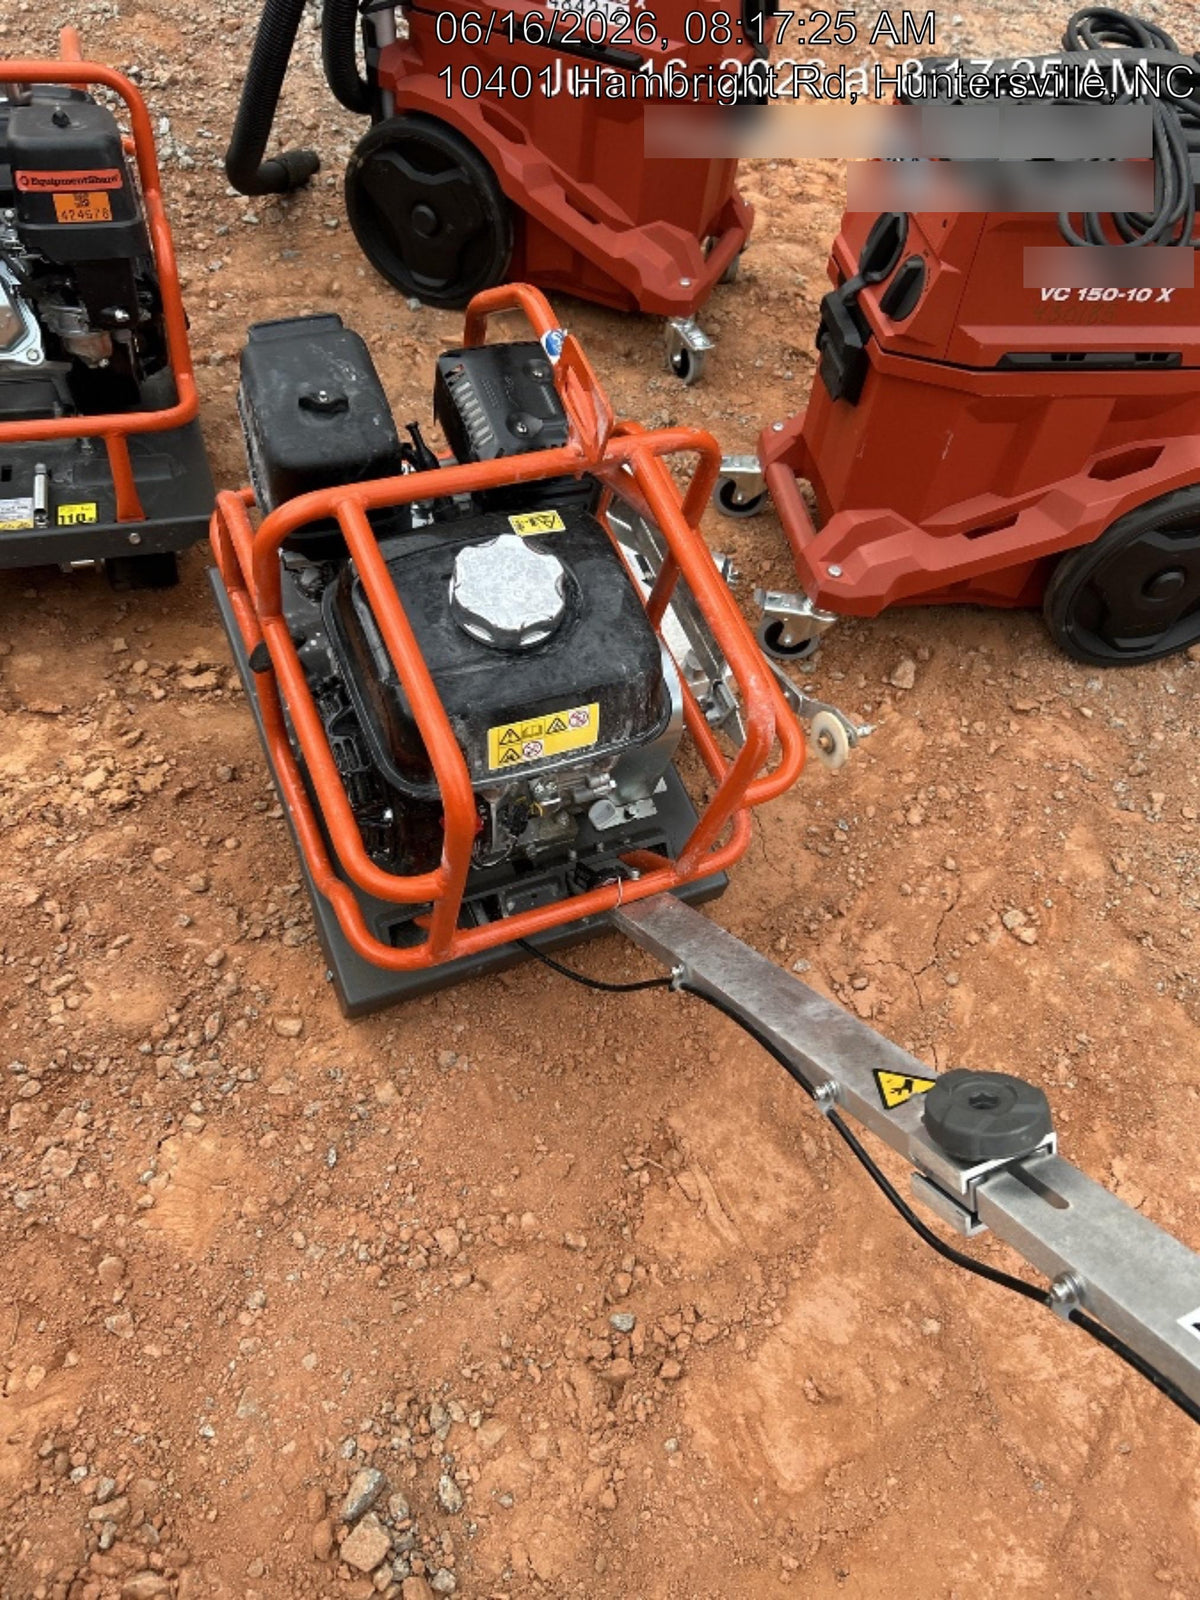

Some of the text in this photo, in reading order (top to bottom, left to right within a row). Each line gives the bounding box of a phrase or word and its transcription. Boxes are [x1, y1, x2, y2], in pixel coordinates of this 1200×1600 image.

[31, 174, 118, 188] EquipmentShare
[1041, 287, 1176, 303] VC 150-10 X
